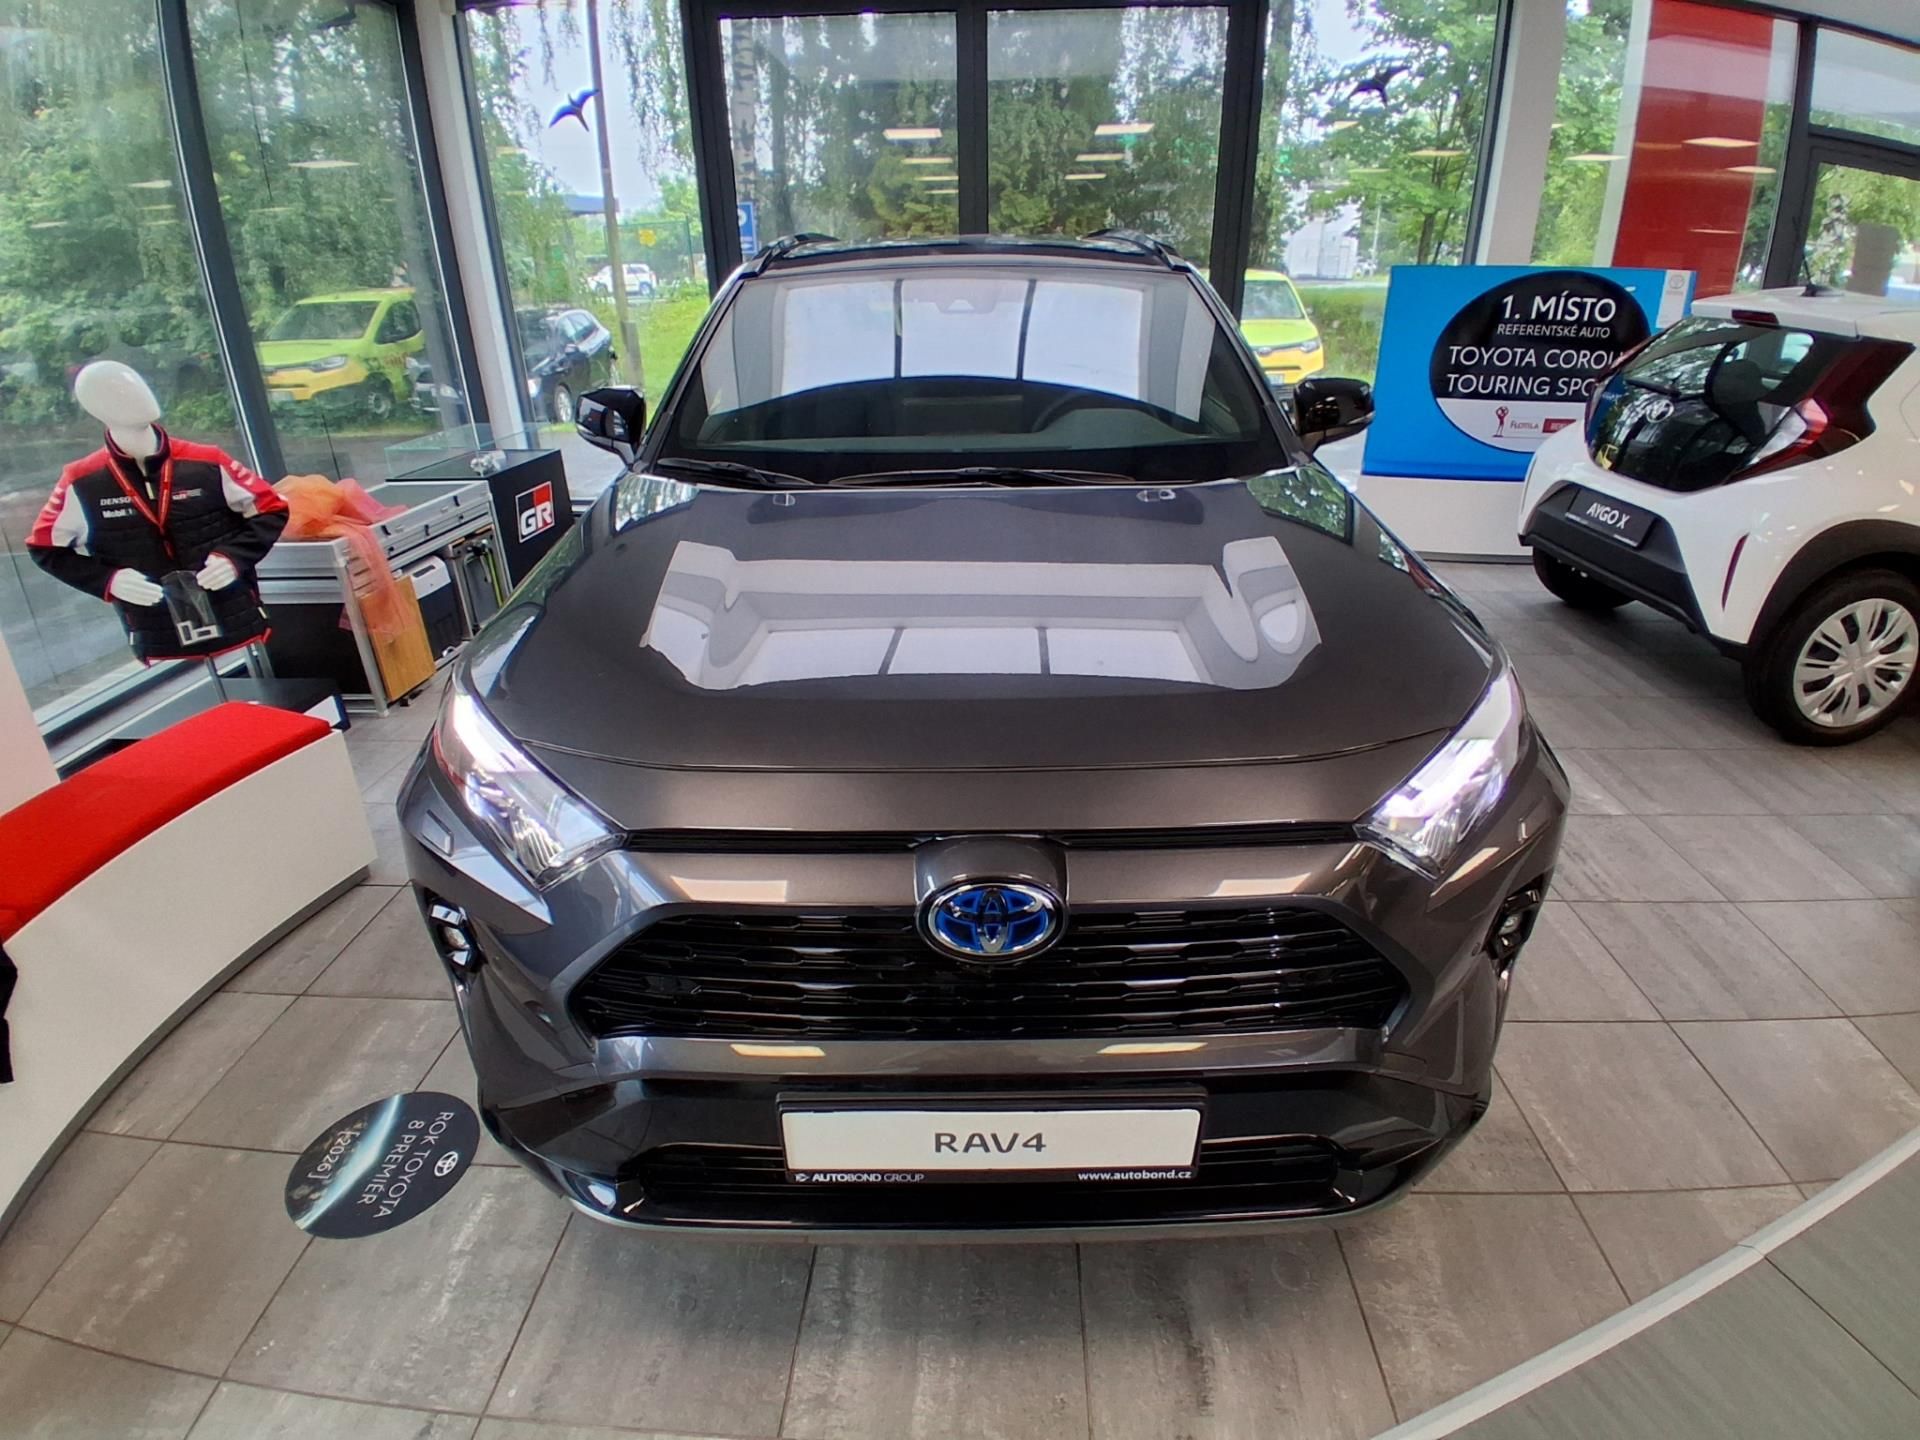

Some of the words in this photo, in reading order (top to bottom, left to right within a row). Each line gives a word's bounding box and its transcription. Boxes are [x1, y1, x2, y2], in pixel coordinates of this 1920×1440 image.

[1502, 294, 1521, 319] 1.
[1531, 290, 1616, 323] MÍSTO
[1497, 323, 1577, 337] REFERENTSKÉ
[1579, 326, 1610, 339] AUTO
[1450, 346, 1537, 367] TOYOTA
[1447, 374, 1550, 396] TOURING
[100, 496, 132, 506] DENSO
[520, 501, 553, 536] GR
[1586, 502, 1619, 525] AYGO
[1617, 513, 1630, 530] X
[408, 1120, 424, 1130] 8
[421, 1111, 454, 1146] ROK
[934, 1132, 1047, 1154] RAV4
[373, 1149, 432, 1218] TOYOTA
[812, 1173, 882, 1183] AUTOBOND
[884, 1173, 924, 1183] GROUP
[1078, 1169, 1191, 1182] www.autobond.cz
